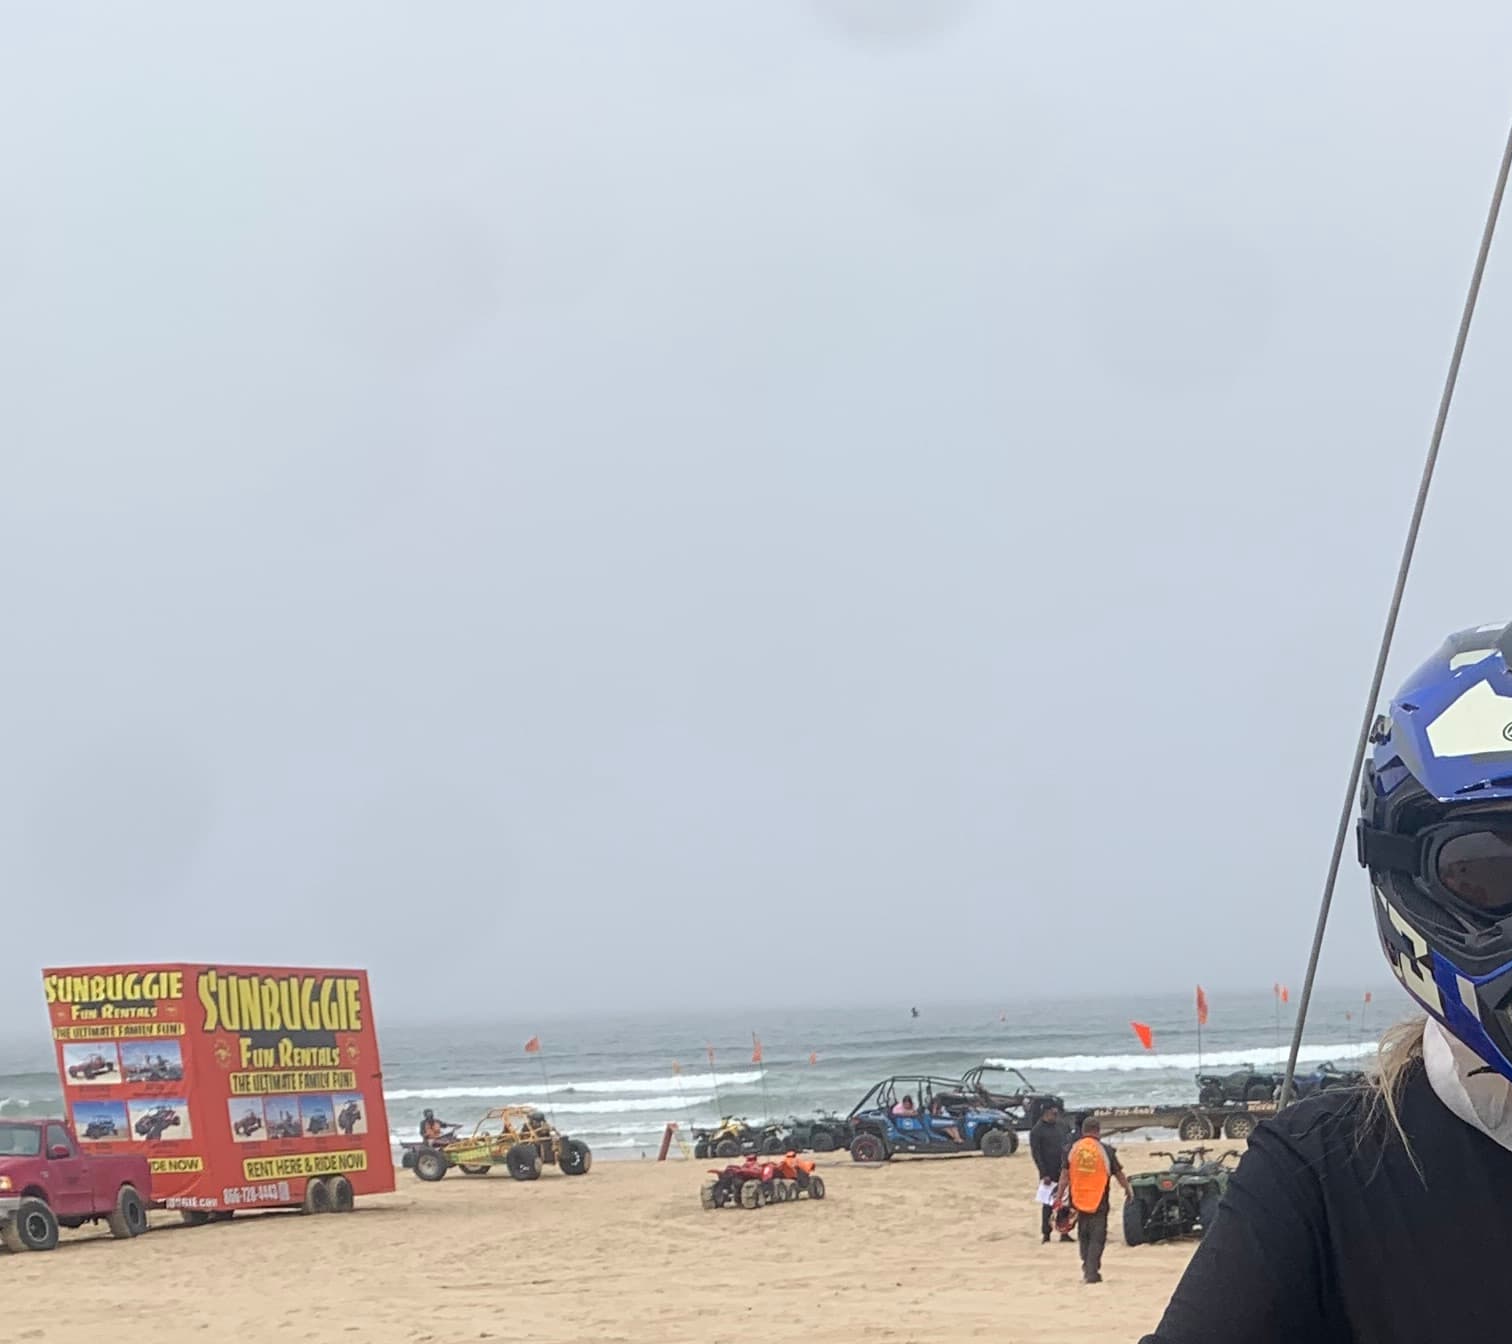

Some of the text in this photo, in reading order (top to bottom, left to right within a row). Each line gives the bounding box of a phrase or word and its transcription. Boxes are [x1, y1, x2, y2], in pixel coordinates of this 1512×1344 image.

[44, 972, 183, 1003] SUNBUGGIE
[71, 1003, 158, 1020] FUN RENTALS
[198, 970, 362, 1031] SUNBUGGIE
[239, 1037, 339, 1068] FUN RENTALS
[232, 1075, 250, 1092] THE
[252, 1073, 296, 1092] ULTIMATE
[168, 1159, 199, 1171] NOW
[246, 1153, 364, 1178] RENT HERE & RIDE NOW
